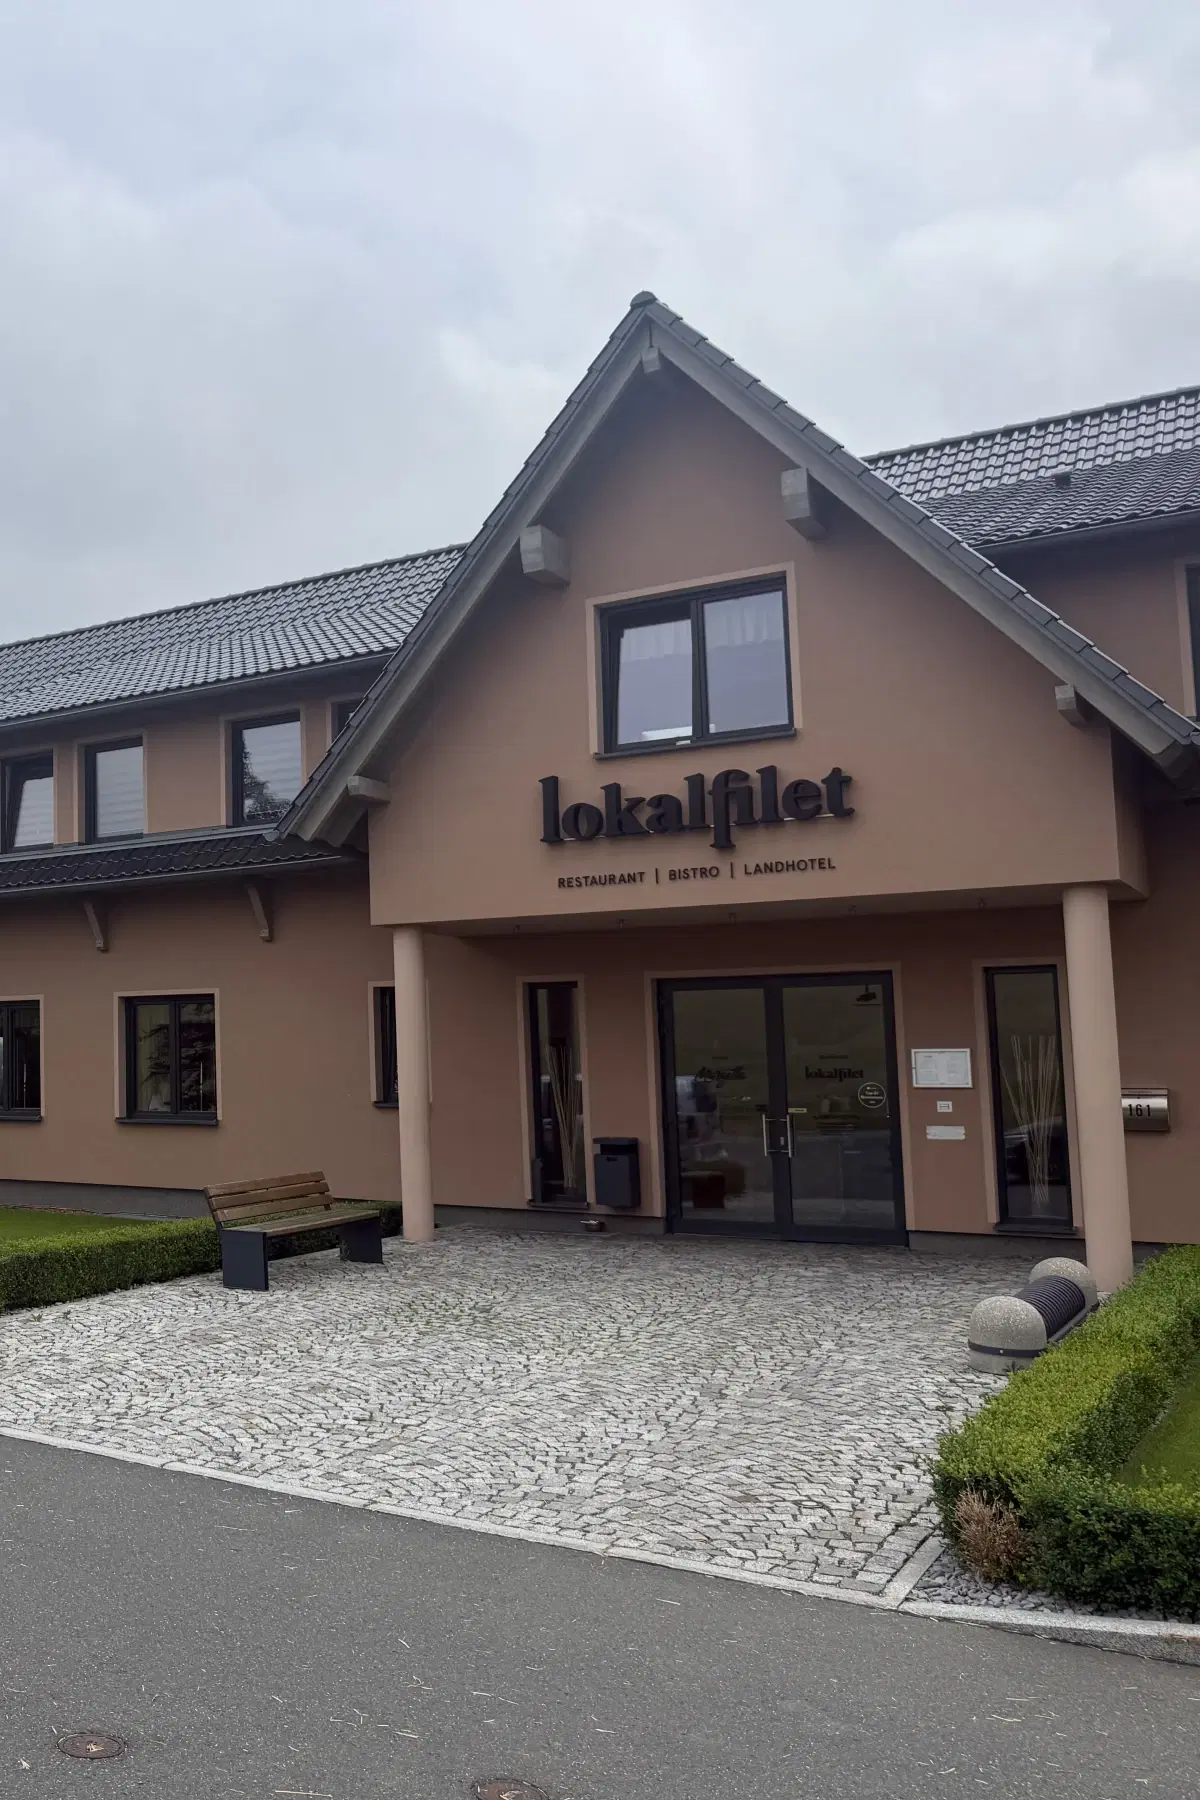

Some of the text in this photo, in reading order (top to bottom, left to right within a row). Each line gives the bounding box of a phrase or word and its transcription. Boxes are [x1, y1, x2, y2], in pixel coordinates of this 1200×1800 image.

[538, 765, 855, 849] lokalfilet
[557, 857, 836, 888] RESTAURANT BISTRO LANDHOTEL
[1128, 1104, 1151, 1117] 161
